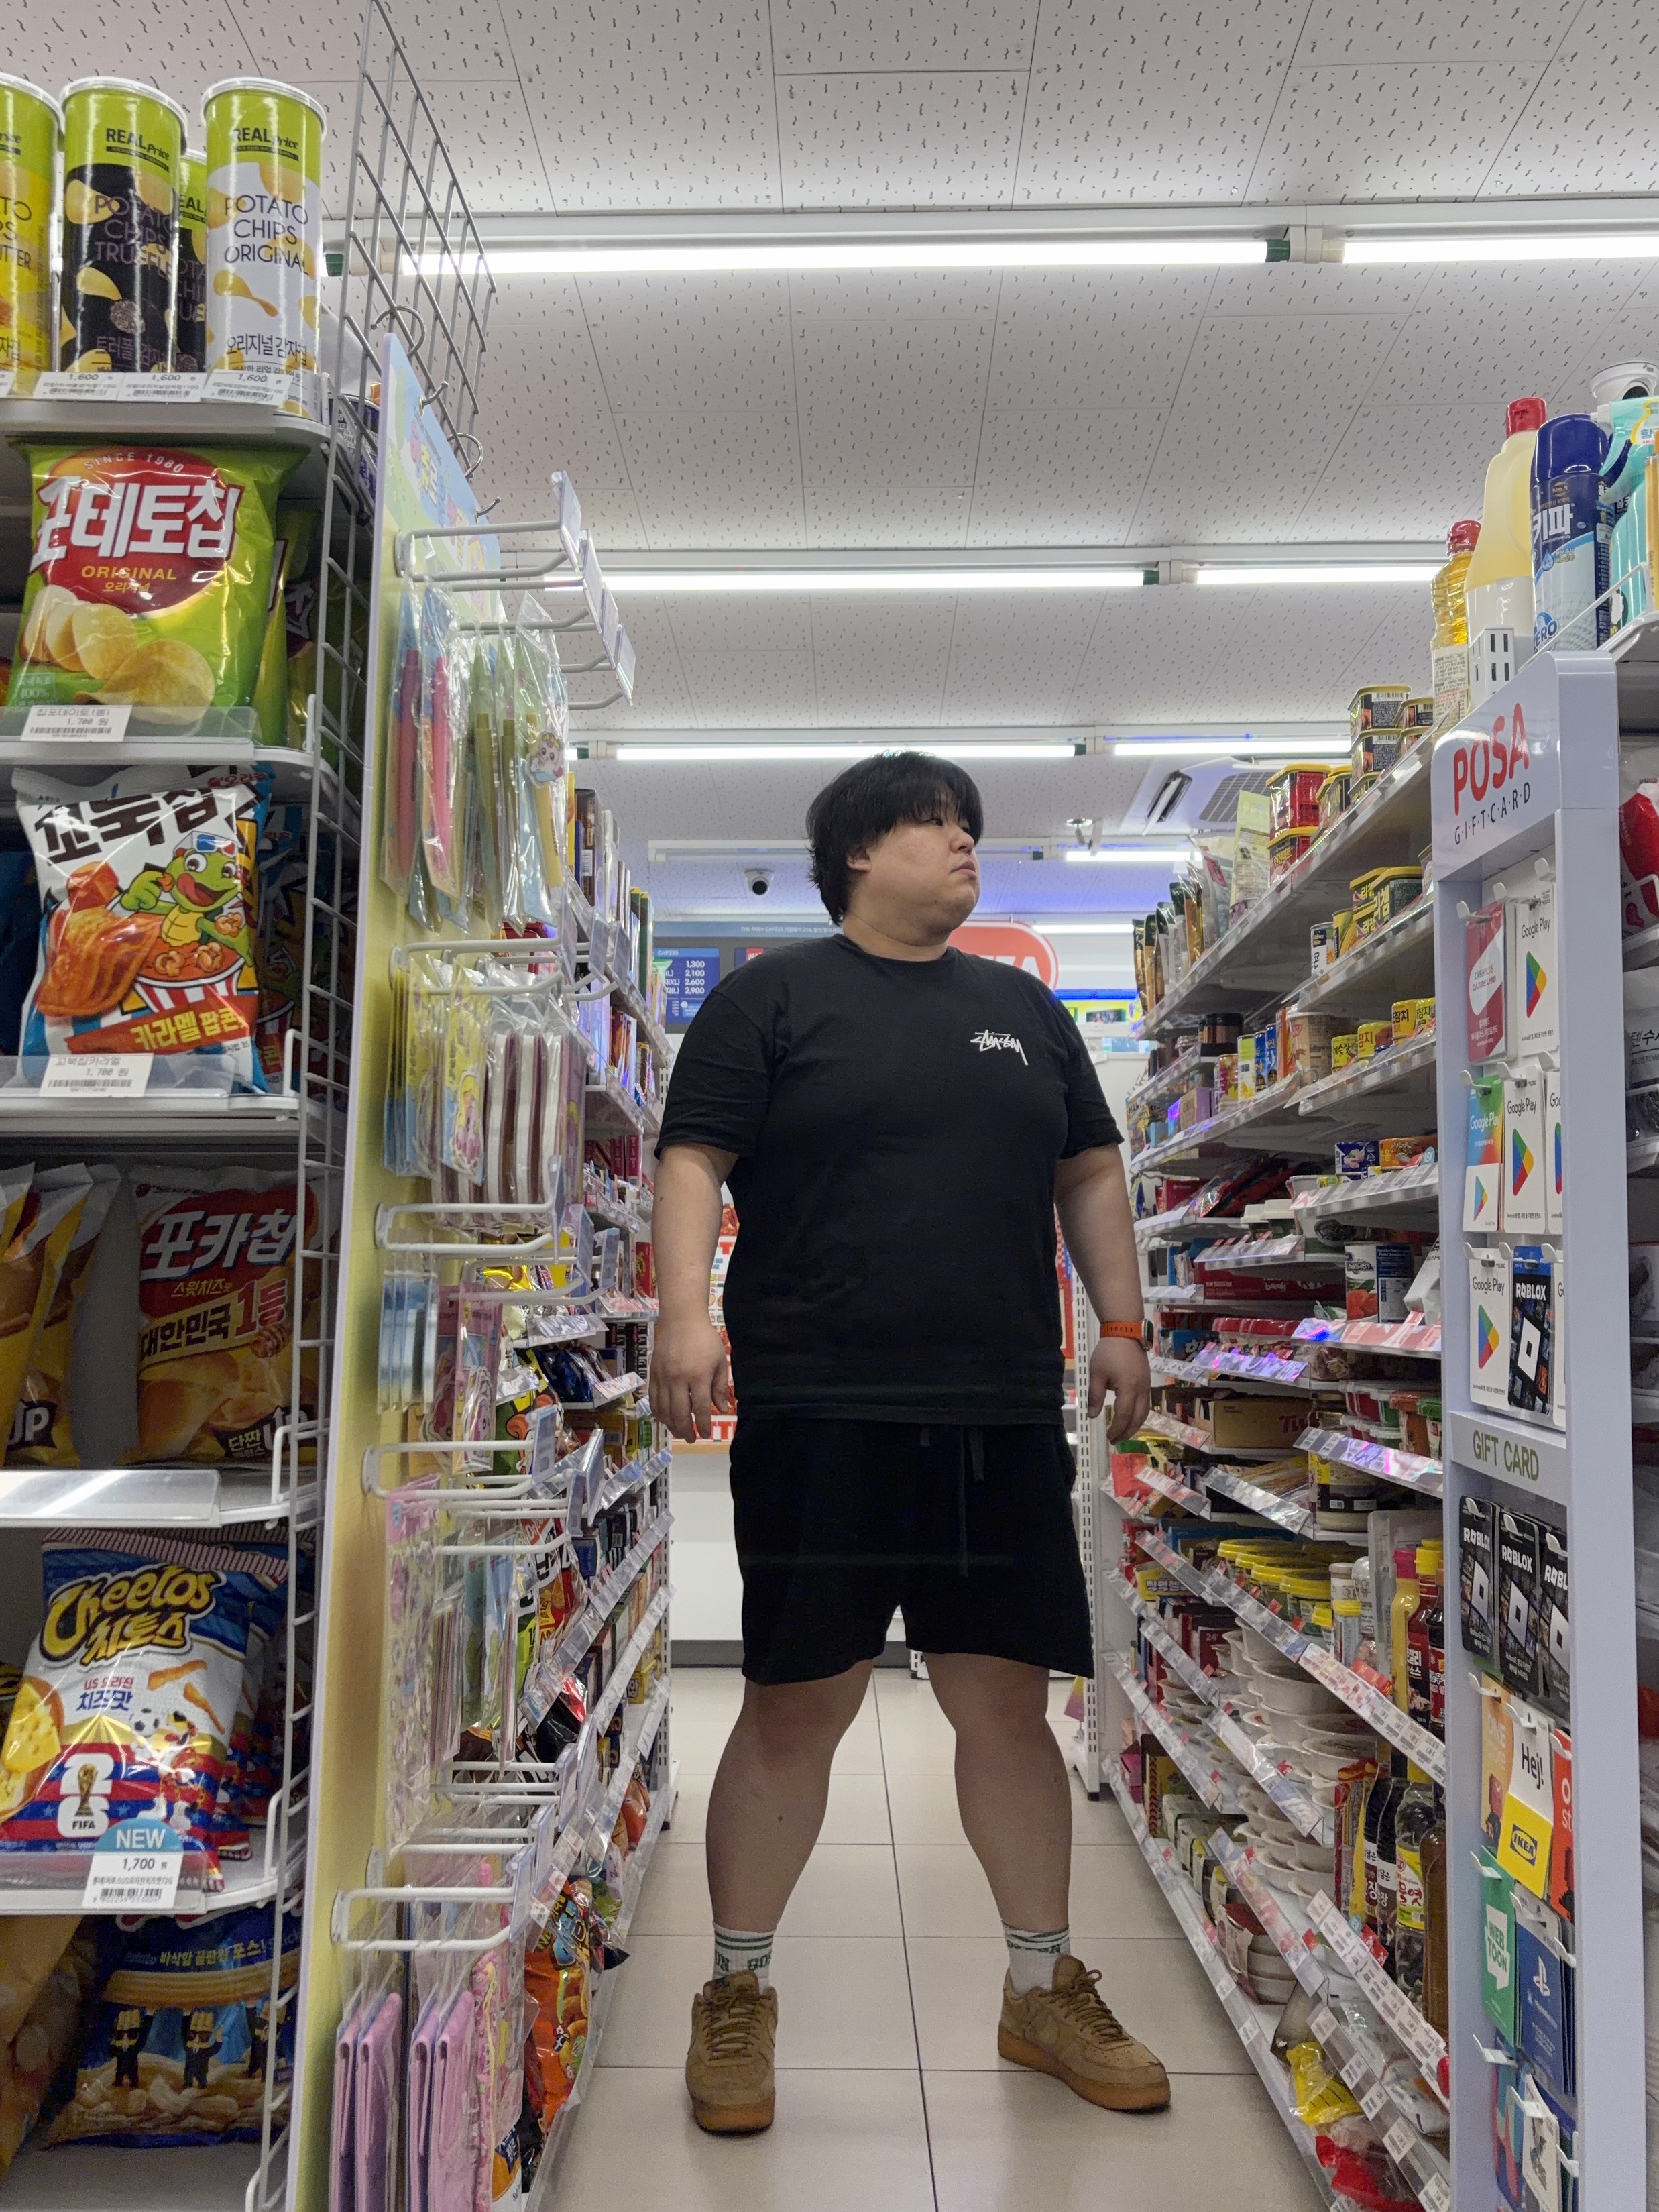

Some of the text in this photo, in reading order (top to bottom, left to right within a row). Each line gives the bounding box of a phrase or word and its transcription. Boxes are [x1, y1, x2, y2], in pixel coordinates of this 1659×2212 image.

[105, 127, 170, 160] REAL Price
[233, 127, 299, 150] REAL Price
[179, 195, 204, 213] EAL
[225, 195, 309, 225] POTATO
[234, 219, 298, 245] CHIPS
[224, 245, 310, 276] ORIGINAL
[226, 333, 274, 355] 오리지널
[83, 452, 185, 474] SINCE 1980
[80, 565, 178, 582] ORIGINAL
[1534, 620, 1558, 648] ERO
[1453, 702, 1530, 816] POSA
[1374, 884, 1390, 920] 리챔
[1521, 917, 1551, 940] Google Play
[685, 969, 705, 977] 2,100
[686, 960, 705, 969] 1,300
[685, 978, 705, 986] 2,600
[685, 987, 705, 995] 2,900
[1393, 1008, 1410, 1024] 참치
[129, 1010, 202, 1051] 카라멜
[1507, 1097, 1537, 1117] Google Play
[1470, 1112, 1489, 1133] Google
[139, 1207, 299, 1281] 포카칩
[1472, 1276, 1505, 1296] Google Play
[1515, 1282, 1546, 1301] ROBLOX
[141, 1301, 234, 1360] 대한민국
[1473, 1430, 1540, 1482] GIFT CARD
[1501, 1544, 1534, 1574] ROBLOX
[43, 1565, 218, 1658] Cheetos
[81, 1611, 188, 1665] 치토스
[84, 1678, 99, 1690] US
[76, 1690, 134, 1711] 치즈맛
[1521, 1742, 1544, 1791] Hej!
[72, 1820, 96, 1830] FIFA
[115, 1828, 166, 1850] NEW
[1513, 1832, 1535, 1857] IKEA
[122, 1857, 156, 1871] 1,700
[1488, 1920, 1505, 1949] WEB
[1486, 1940, 1508, 1973] TOON
